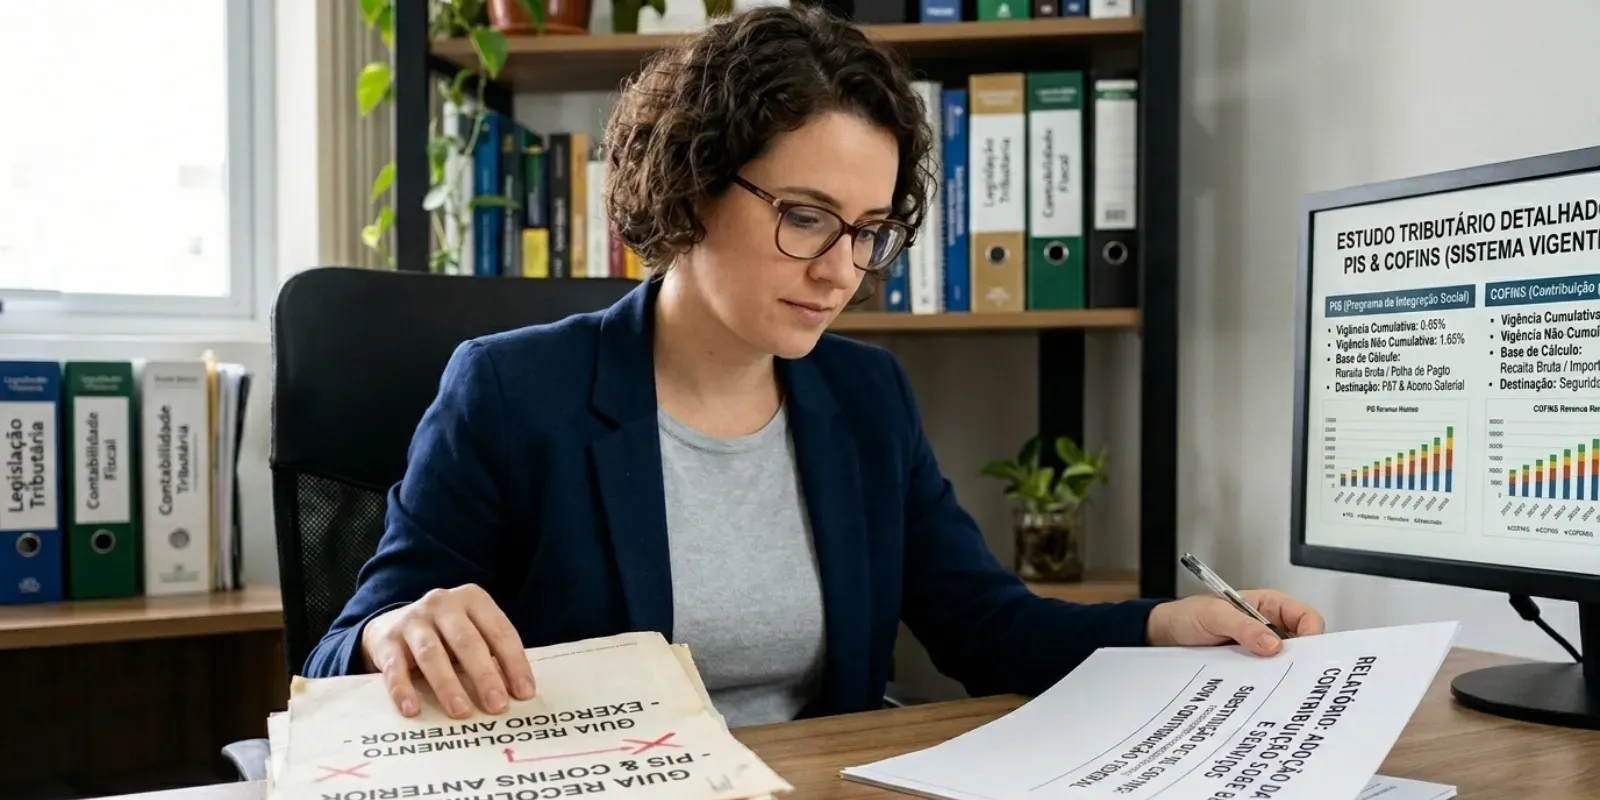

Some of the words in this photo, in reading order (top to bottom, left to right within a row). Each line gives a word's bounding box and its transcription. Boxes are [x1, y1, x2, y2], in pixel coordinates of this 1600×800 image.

[1337, 226, 1395, 250] ESTUDO
[1399, 211, 1495, 242] TRIBUTÁRIO
[1501, 199, 1600, 231] DETALHAD
[1344, 255, 1366, 274] PIS
[1370, 253, 1380, 272] &
[1385, 247, 1440, 270] COFINS
[1445, 238, 1524, 269] (SISTEMA
[1529, 229, 1600, 256] VIGENT
[1335, 353, 1355, 364] Base
[1357, 353, 1367, 363] de
[1500, 346, 1524, 358] Base
[1526, 345, 1539, 357] de
[1541, 343, 1582, 356] Cálculo:
[1414, 365, 1425, 376] de
[1500, 377, 1556, 392] Destinação:
[7, 418, 28, 512] Legislação
[29, 420, 45, 509] Tributária
[86, 411, 98, 510] Contabilidade
[158, 404, 172, 516] Contabilidade
[506, 701, 645, 729] EXERCÍCIO
[574, 718, 635, 734] GUIA
[361, 720, 497, 745] ANTERIOR
[363, 727, 568, 758] RECOLHIMENTO
[620, 760, 639, 771] &
[647, 753, 694, 768] PIS
[1270, 733, 1325, 783] ADOÇÃO
[496, 764, 611, 787] COFINS
[614, 769, 691, 788] GUIA
[1249, 784, 1281, 799] DA
